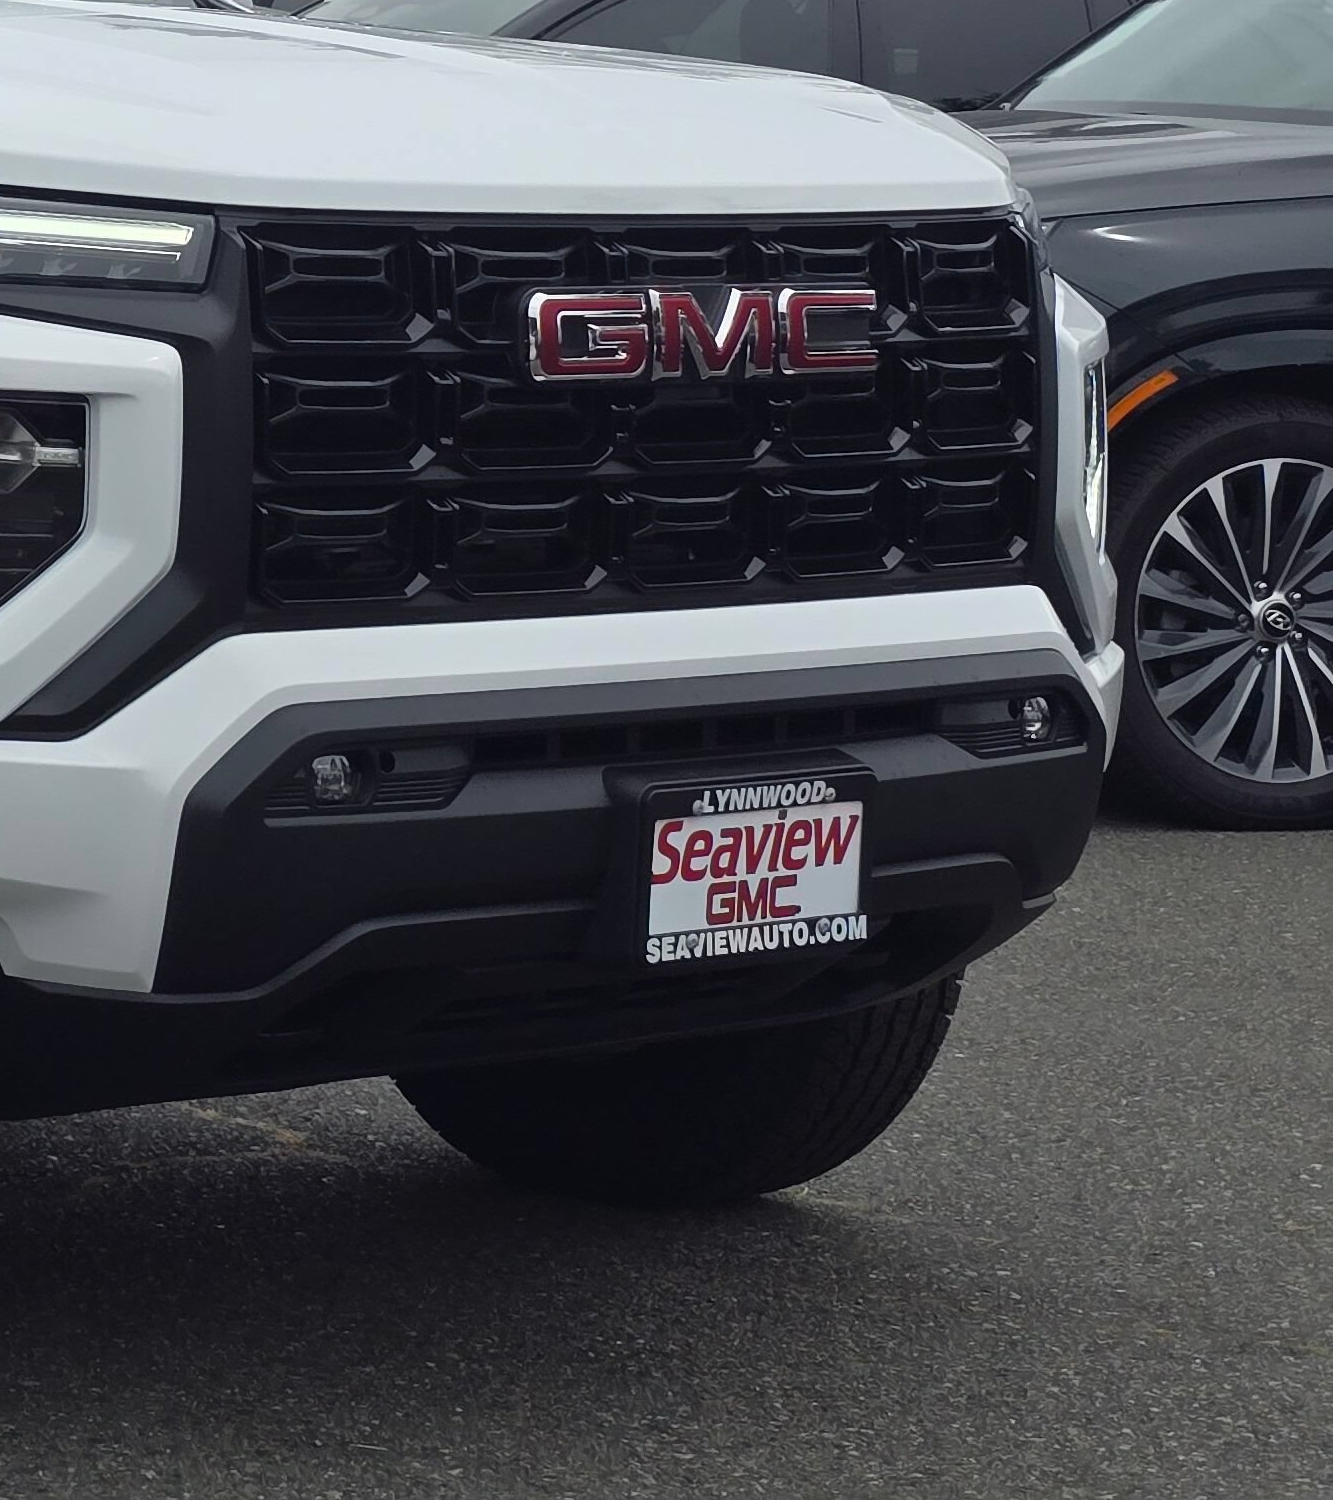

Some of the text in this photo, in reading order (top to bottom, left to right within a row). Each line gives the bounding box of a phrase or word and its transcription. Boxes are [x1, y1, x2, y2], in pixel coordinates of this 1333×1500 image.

[528, 287, 877, 381] GMC
[702, 780, 827, 814] LYNNWOOD
[651, 811, 859, 884] Seaview
[706, 874, 802, 926] GMC
[645, 914, 868, 964] SEAVIEWAUTO.COM
